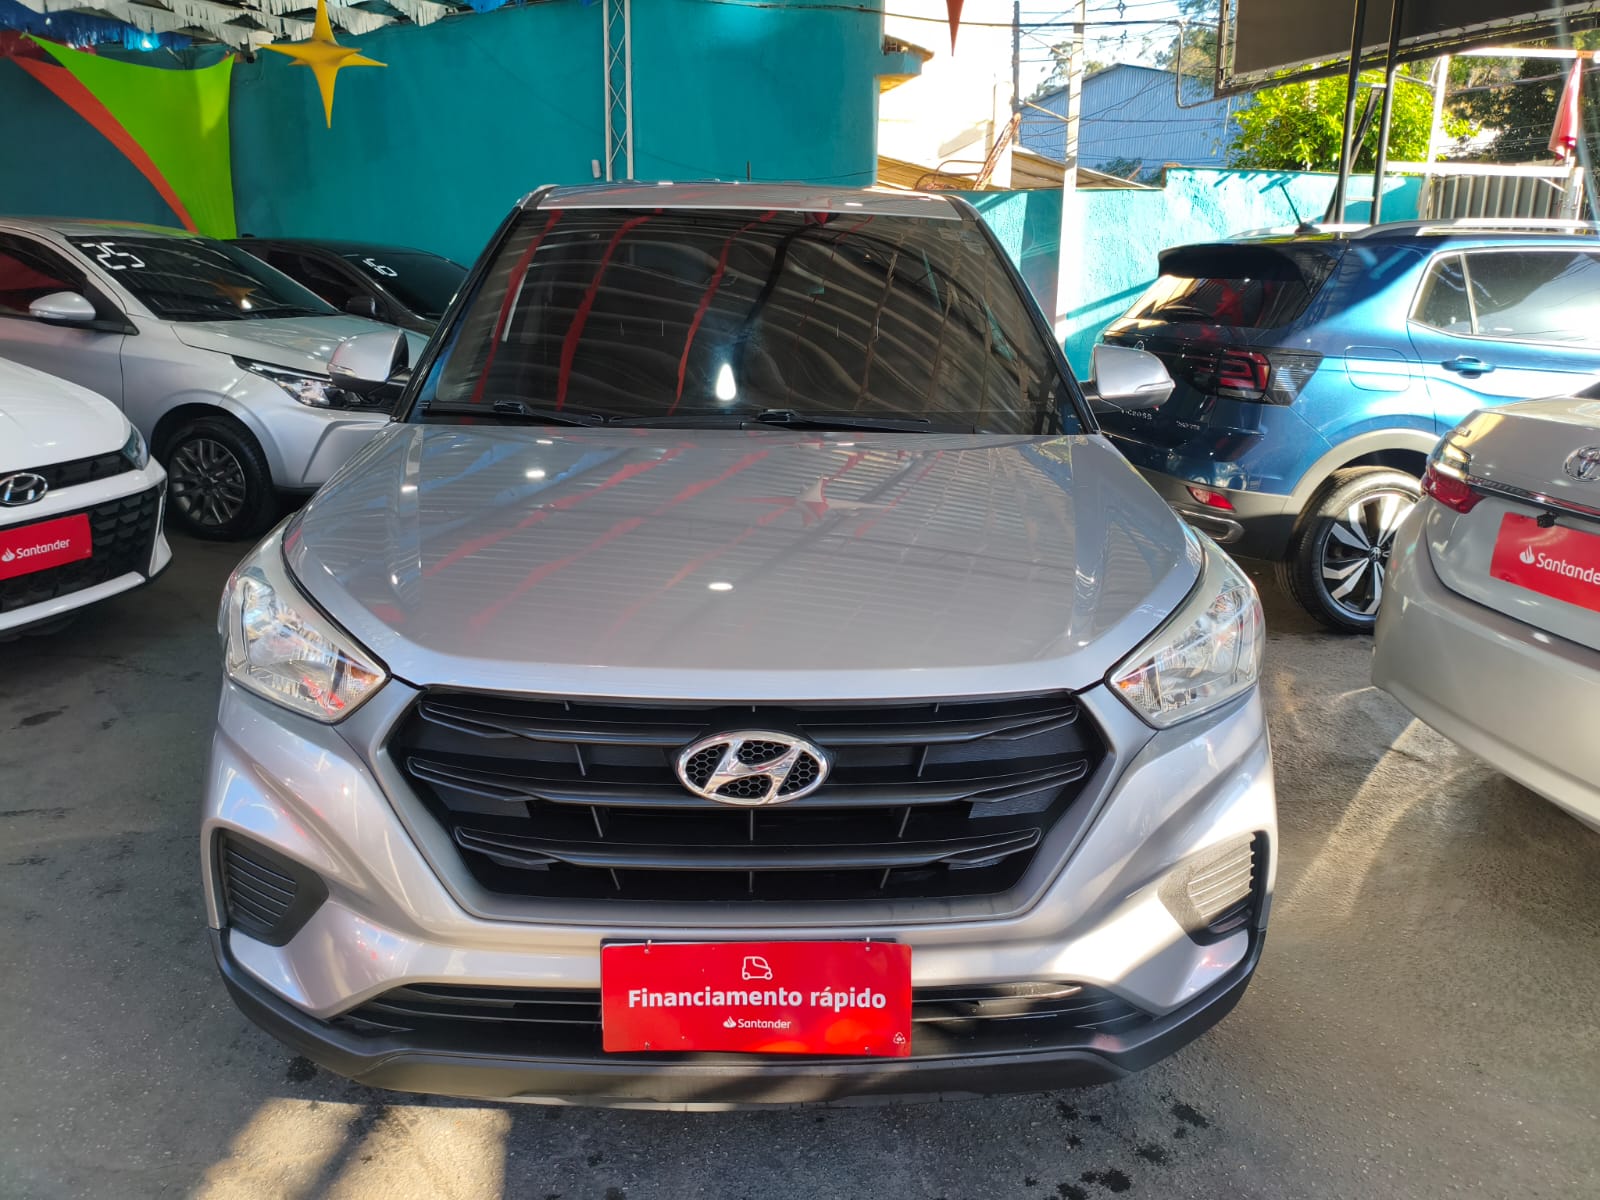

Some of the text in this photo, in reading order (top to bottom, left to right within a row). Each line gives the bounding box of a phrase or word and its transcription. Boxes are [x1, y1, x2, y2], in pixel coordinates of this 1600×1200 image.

[81, 242, 146, 270] 25
[16, 539, 71, 559] Santander
[627, 986, 887, 1013] Financiamento rápido
[737, 1018, 792, 1029] Santander
